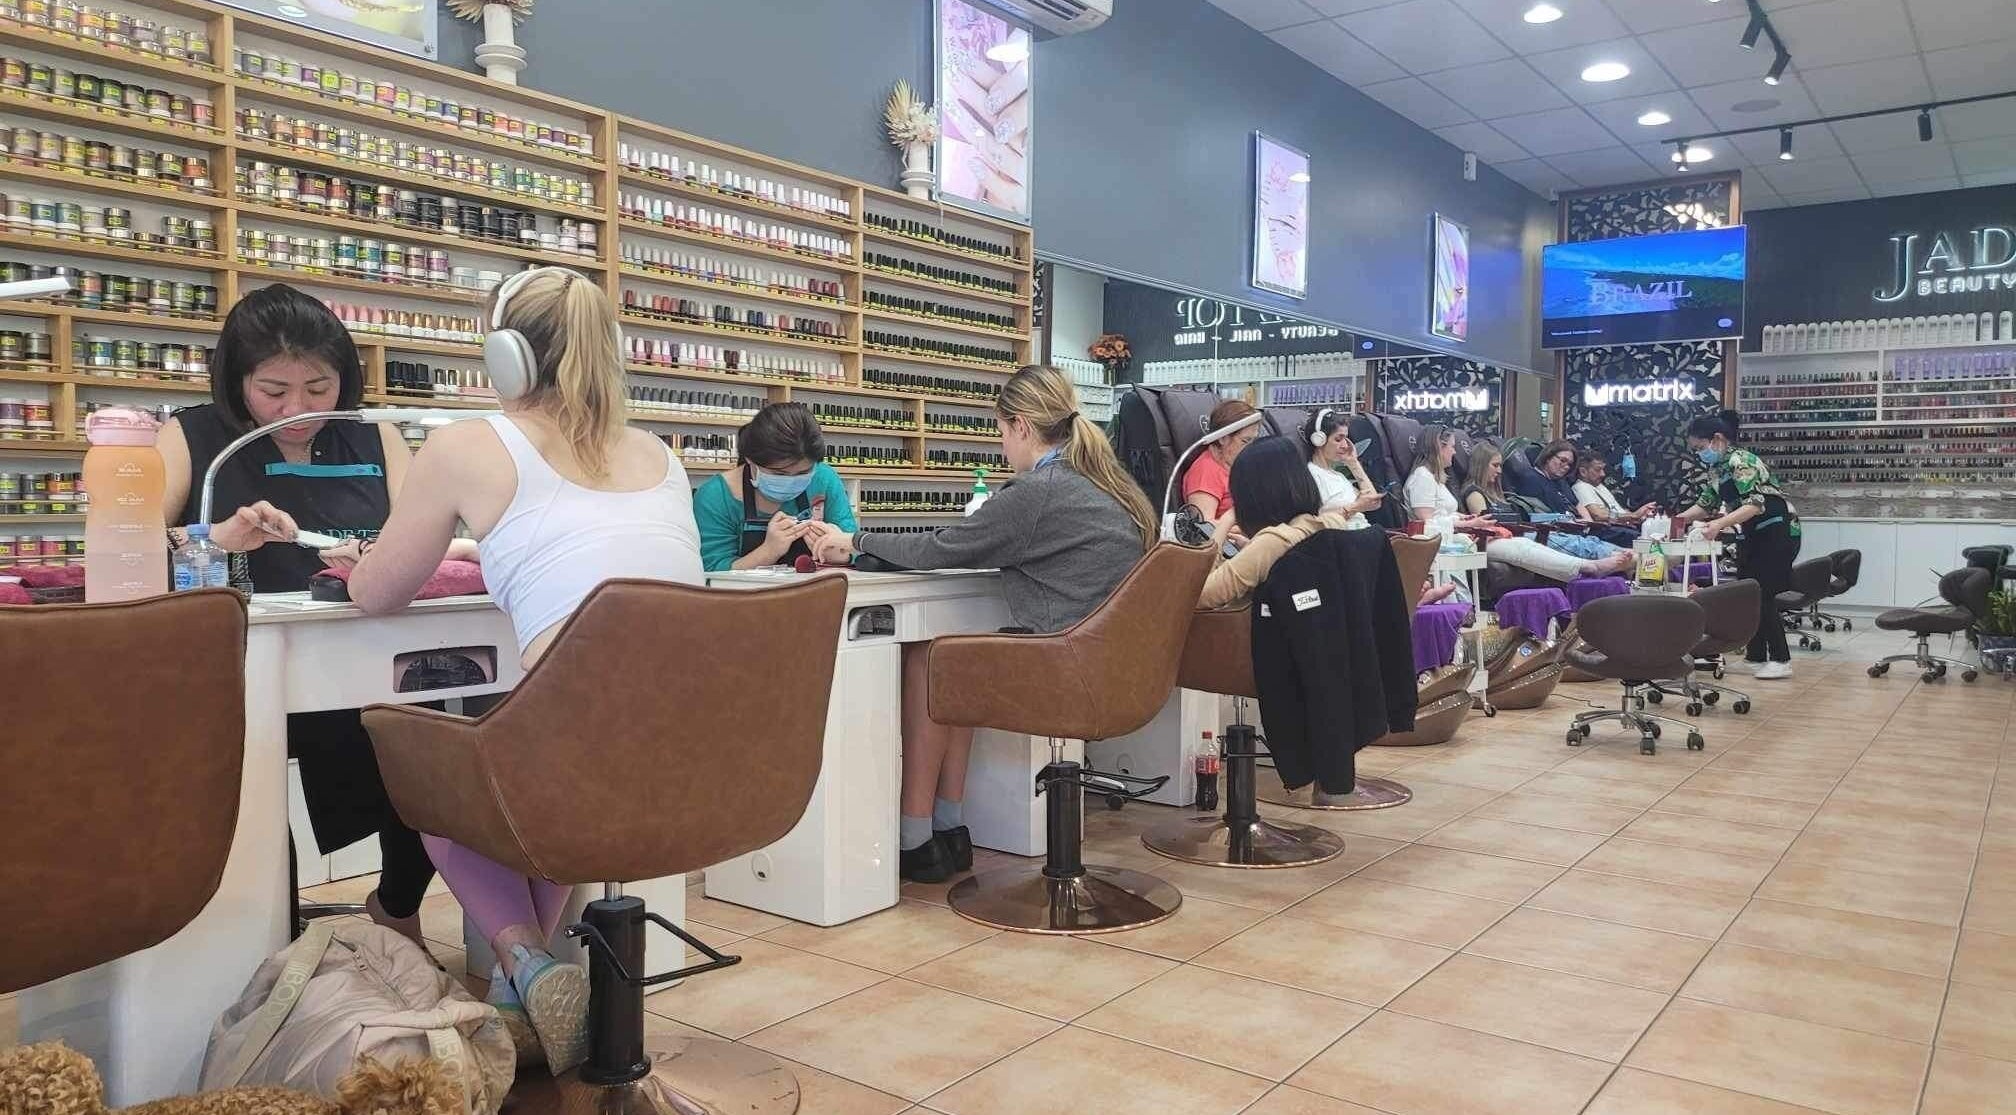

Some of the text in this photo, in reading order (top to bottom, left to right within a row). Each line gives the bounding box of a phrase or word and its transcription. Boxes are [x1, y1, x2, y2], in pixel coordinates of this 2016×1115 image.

[1872, 227, 2016, 301] JAD
[1593, 280, 1692, 306] BRAZIL
[1917, 273, 2016, 296] BEAUTY
